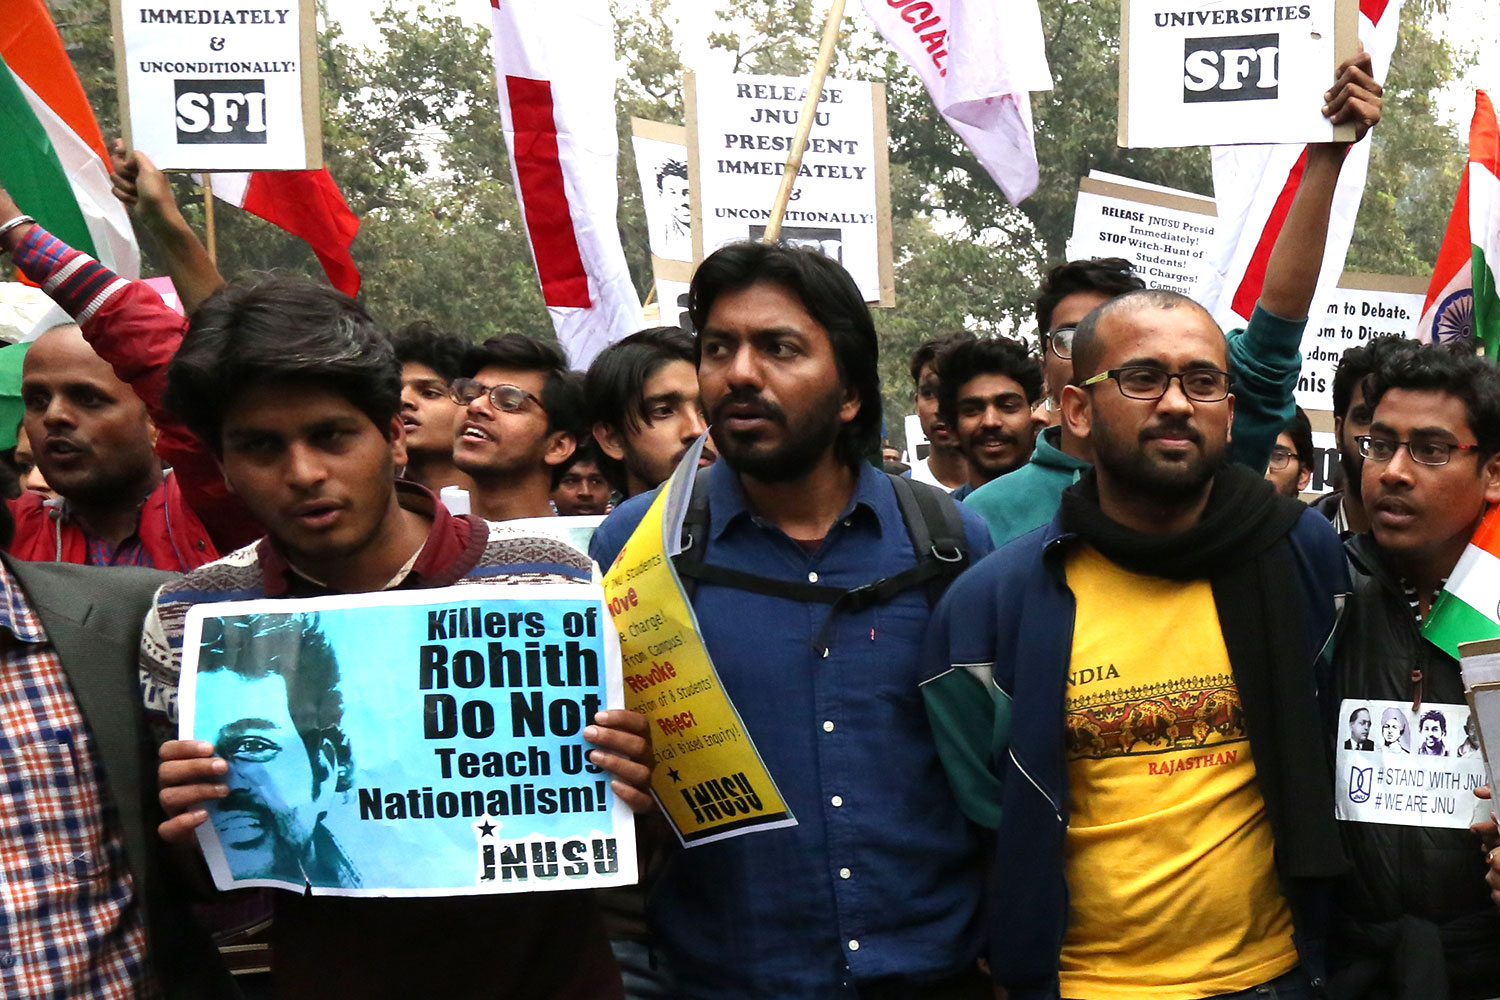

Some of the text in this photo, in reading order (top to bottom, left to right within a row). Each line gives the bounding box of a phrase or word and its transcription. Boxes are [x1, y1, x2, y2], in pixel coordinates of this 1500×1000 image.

[140, 9, 290, 25] IMMEDIATELY
[1154, 5, 1311, 28] UNIVERSITIES
[209, 36, 226, 51] &
[140, 61, 296, 74] UNCONDITIONALLY!
[1184, 46, 1279, 92] SFI
[175, 91, 267, 133] SFI
[750, 108, 831, 127] JNUU
[724, 133, 858, 155] PRESIENT
[717, 160, 867, 180] IMMEDATELY
[715, 207, 874, 224] UNCONITIONALLY!
[1101, 206, 1145, 223] RELEASE
[1148, 216, 1180, 229] JNUSU
[1099, 231, 1204, 259] STOP Witch-Hunt of
[1129, 225, 1200, 246] Immediately!
[1136, 252, 1187, 269] Students!
[1149, 267, 1198, 283] Charges!
[1343, 302, 1356, 315] to
[1361, 302, 1410, 320] Debate.
[1340, 326, 1353, 339] to
[427, 606, 598, 642] Killers of
[628, 608, 666, 638] Charge!
[647, 630, 687, 657] Campus!
[419, 641, 599, 691] Rohith
[677, 674, 715, 701] Students!
[423, 690, 602, 740] Do Not
[703, 723, 741, 748] Enquiry!
[435, 744, 604, 779] Teach Us
[1148, 750, 1237, 776] RAJASTHAN
[1377, 767, 1424, 787] #STAND
[1429, 771, 1461, 790] WITH
[358, 780, 607, 821] Nationalism!
[680, 771, 763, 824] JNUSU
[1405, 795, 1429, 813] ARE
[1431, 797, 1456, 815] JNU
[481, 838, 619, 882] JNUSU
